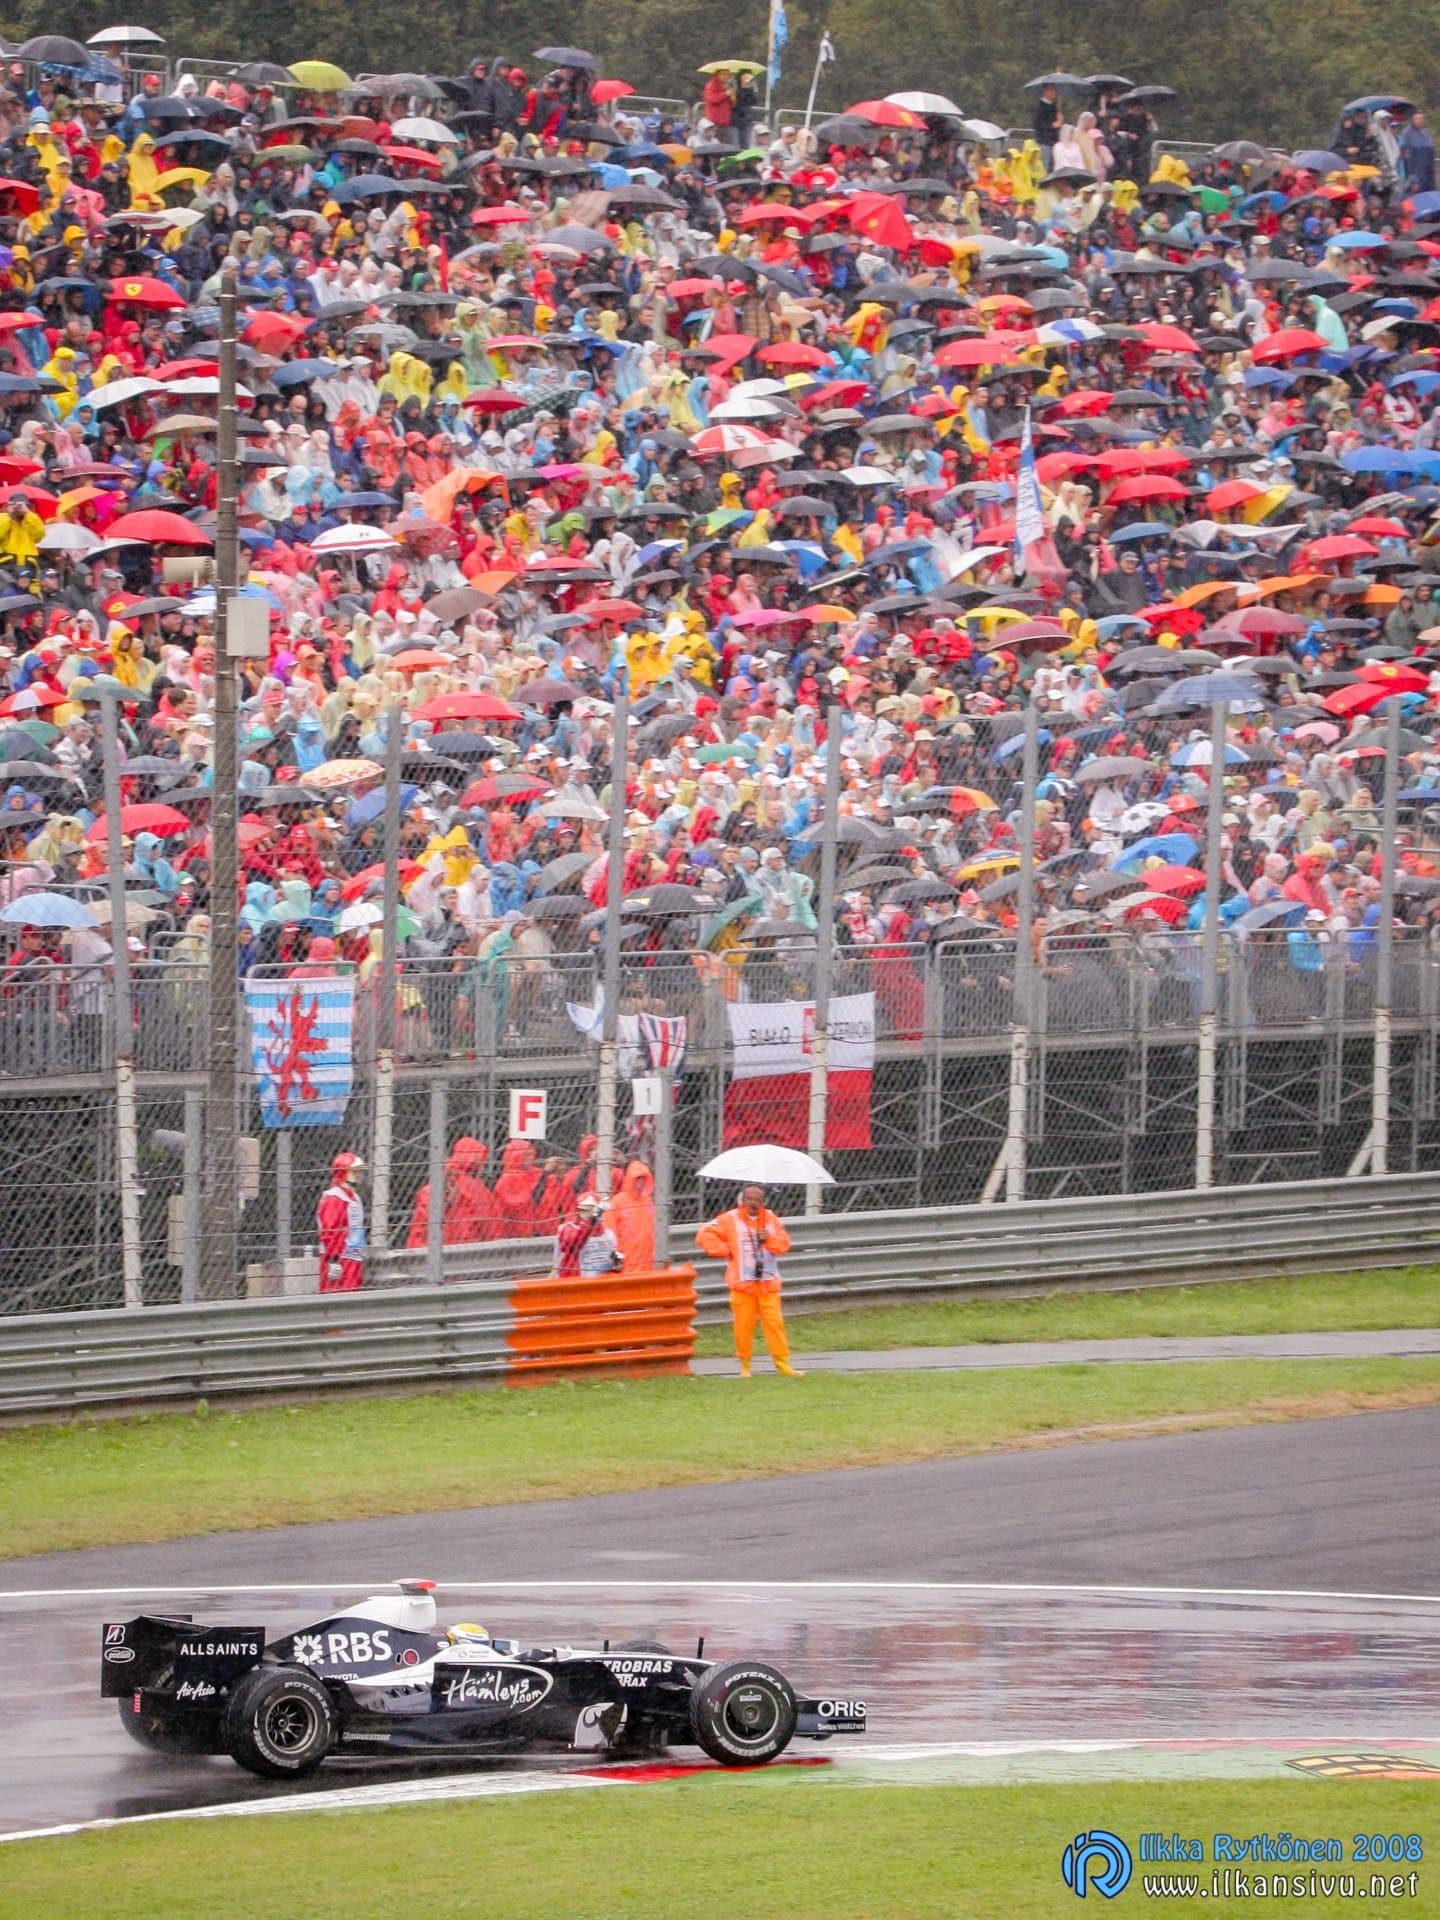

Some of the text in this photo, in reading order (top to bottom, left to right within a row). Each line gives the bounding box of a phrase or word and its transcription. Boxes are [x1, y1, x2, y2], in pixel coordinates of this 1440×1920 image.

[518, 1095, 543, 1132] F
[180, 1643, 258, 1656] ALLSAINTS
[327, 1630, 392, 1664] RBS
[585, 1660, 673, 1673] TROBRAS
[441, 1669, 530, 1709] Hamleys
[724, 1671, 782, 1691] POTENZA
[818, 1700, 867, 1717] ORIS
